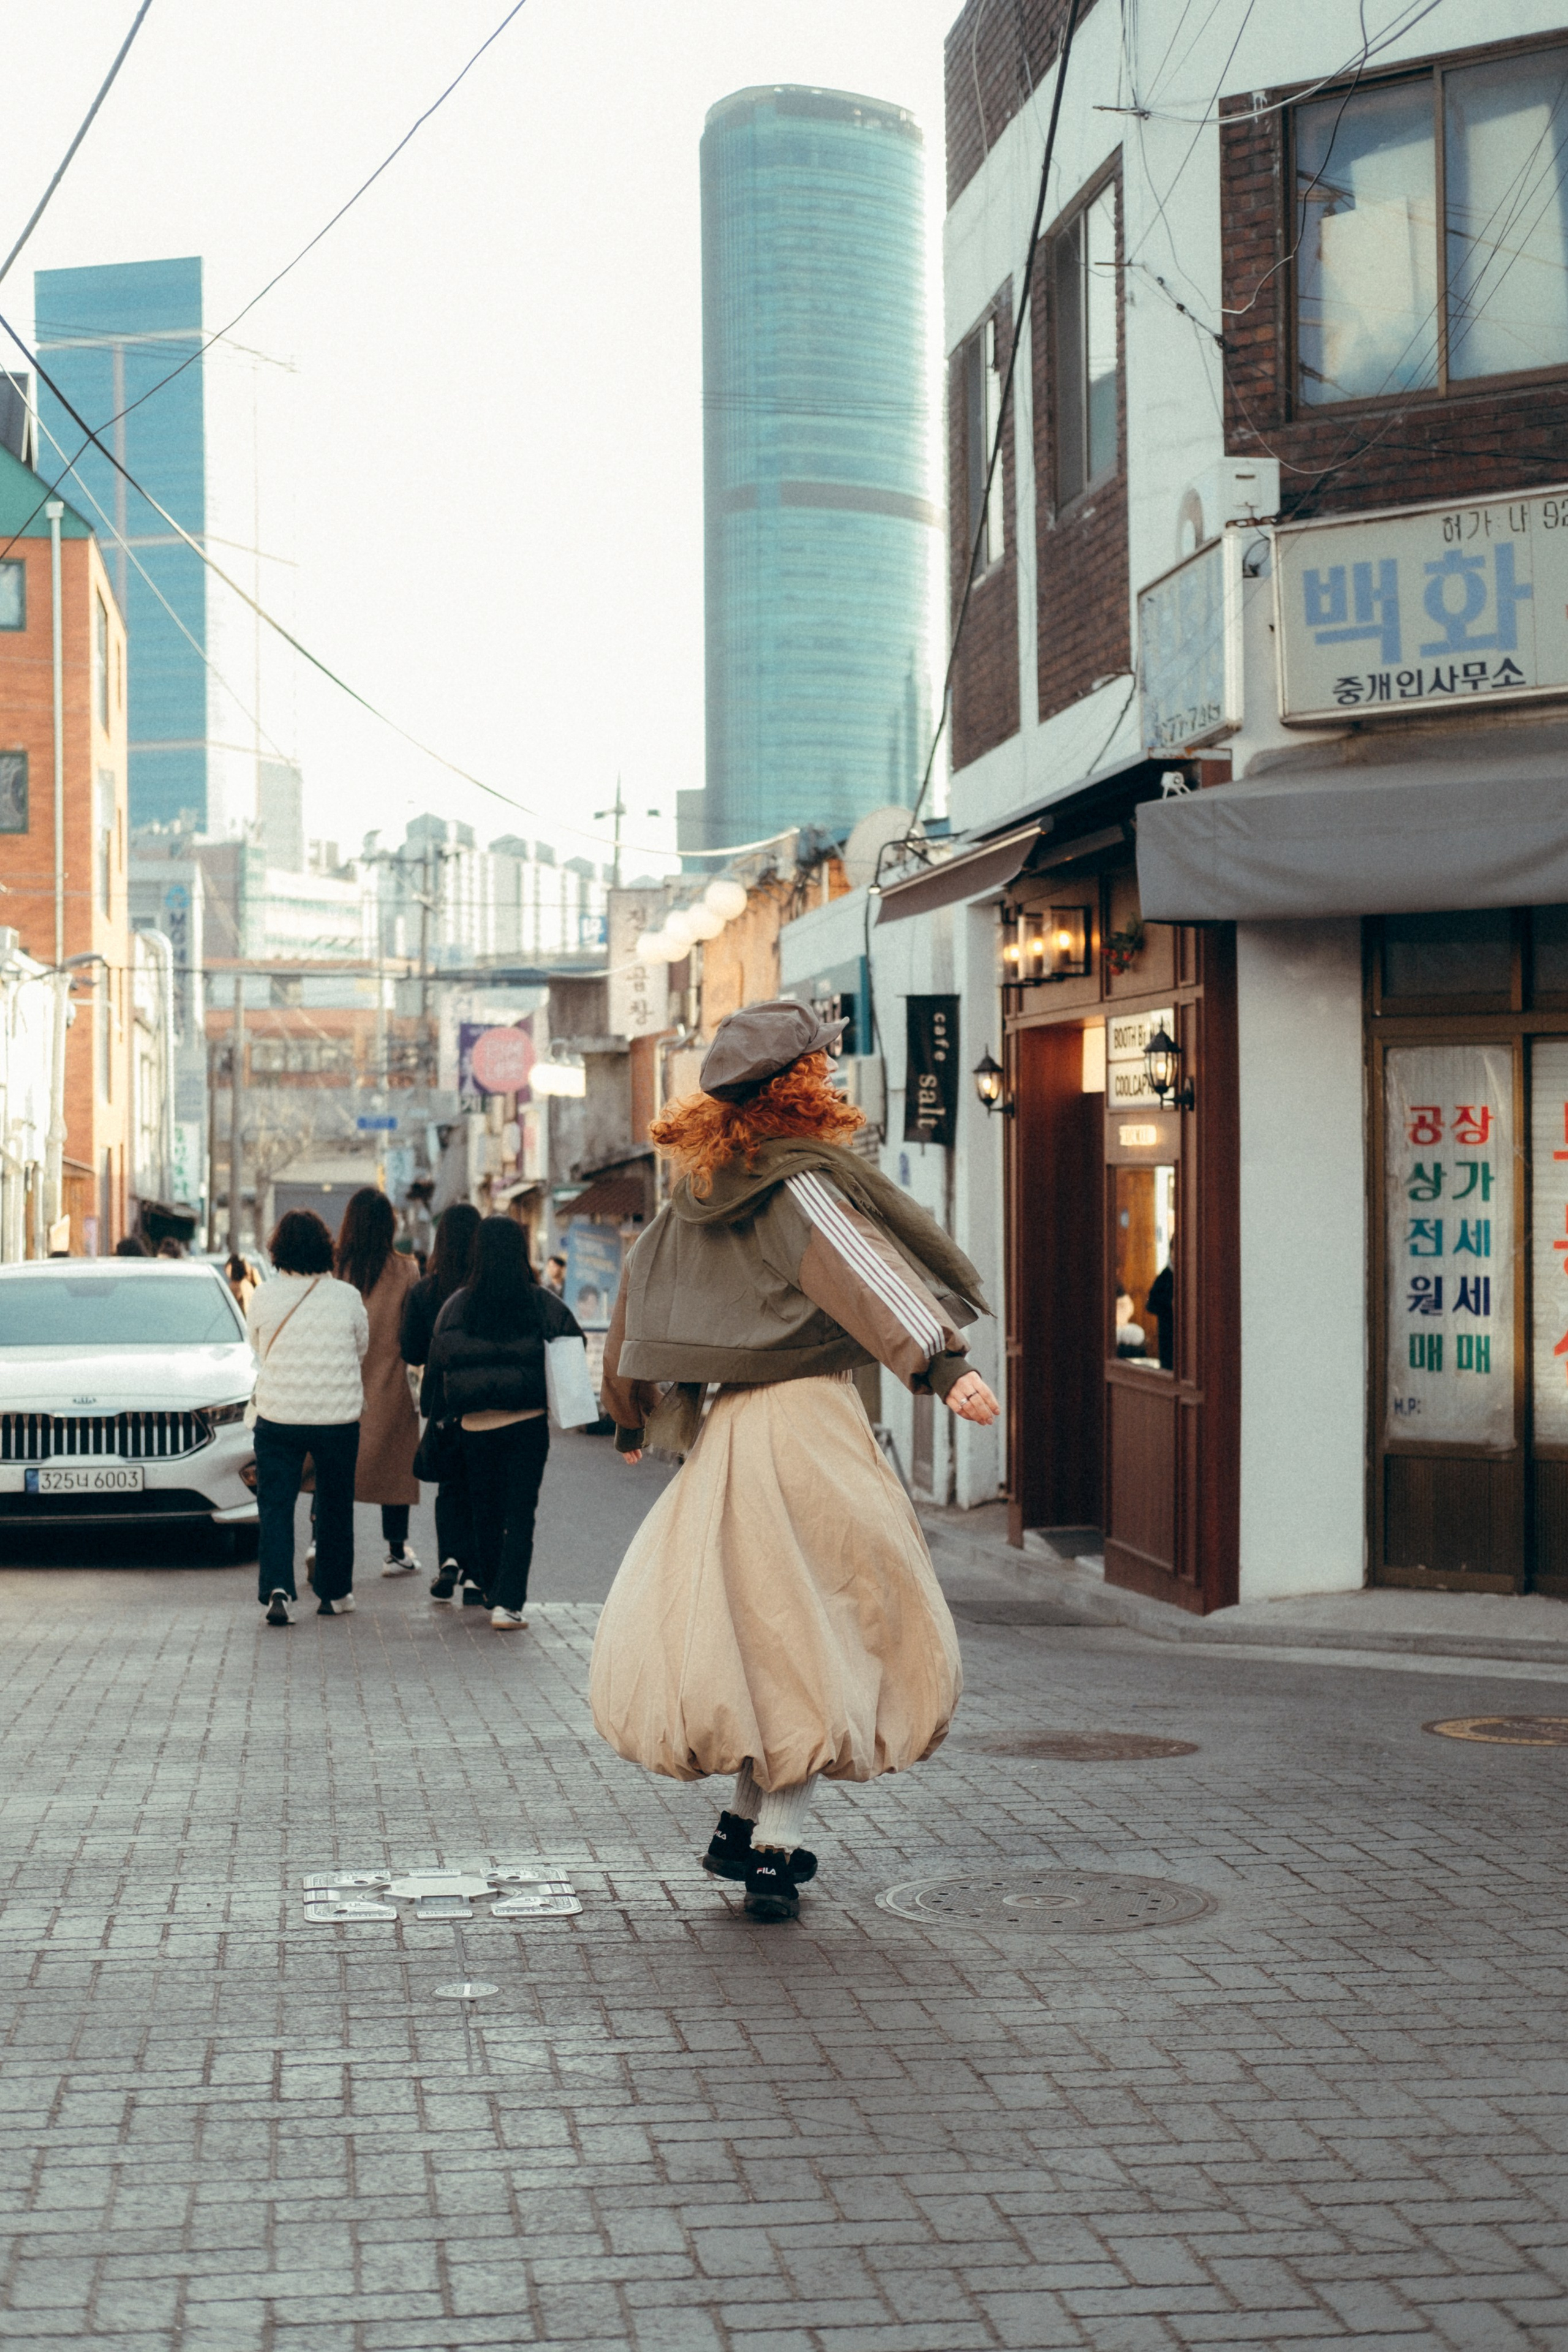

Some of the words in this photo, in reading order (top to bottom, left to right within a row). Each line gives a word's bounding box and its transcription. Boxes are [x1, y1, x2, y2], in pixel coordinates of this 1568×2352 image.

[1303, 541, 1534, 665] 백화
[1332, 657, 1527, 706] 중개인사무소
[933, 1012, 949, 1062] cafe
[917, 1074, 946, 1129] salt
[1404, 1105, 1494, 1146] 공장
[1405, 1161, 1495, 1202] 상가
[1404, 1218, 1490, 1257] 전세
[1407, 1275, 1490, 1316] 월세
[1409, 1333, 1490, 1374] 매매
[94, 1471, 138, 1489] 6003
[756, 1867, 777, 1875] FILA
